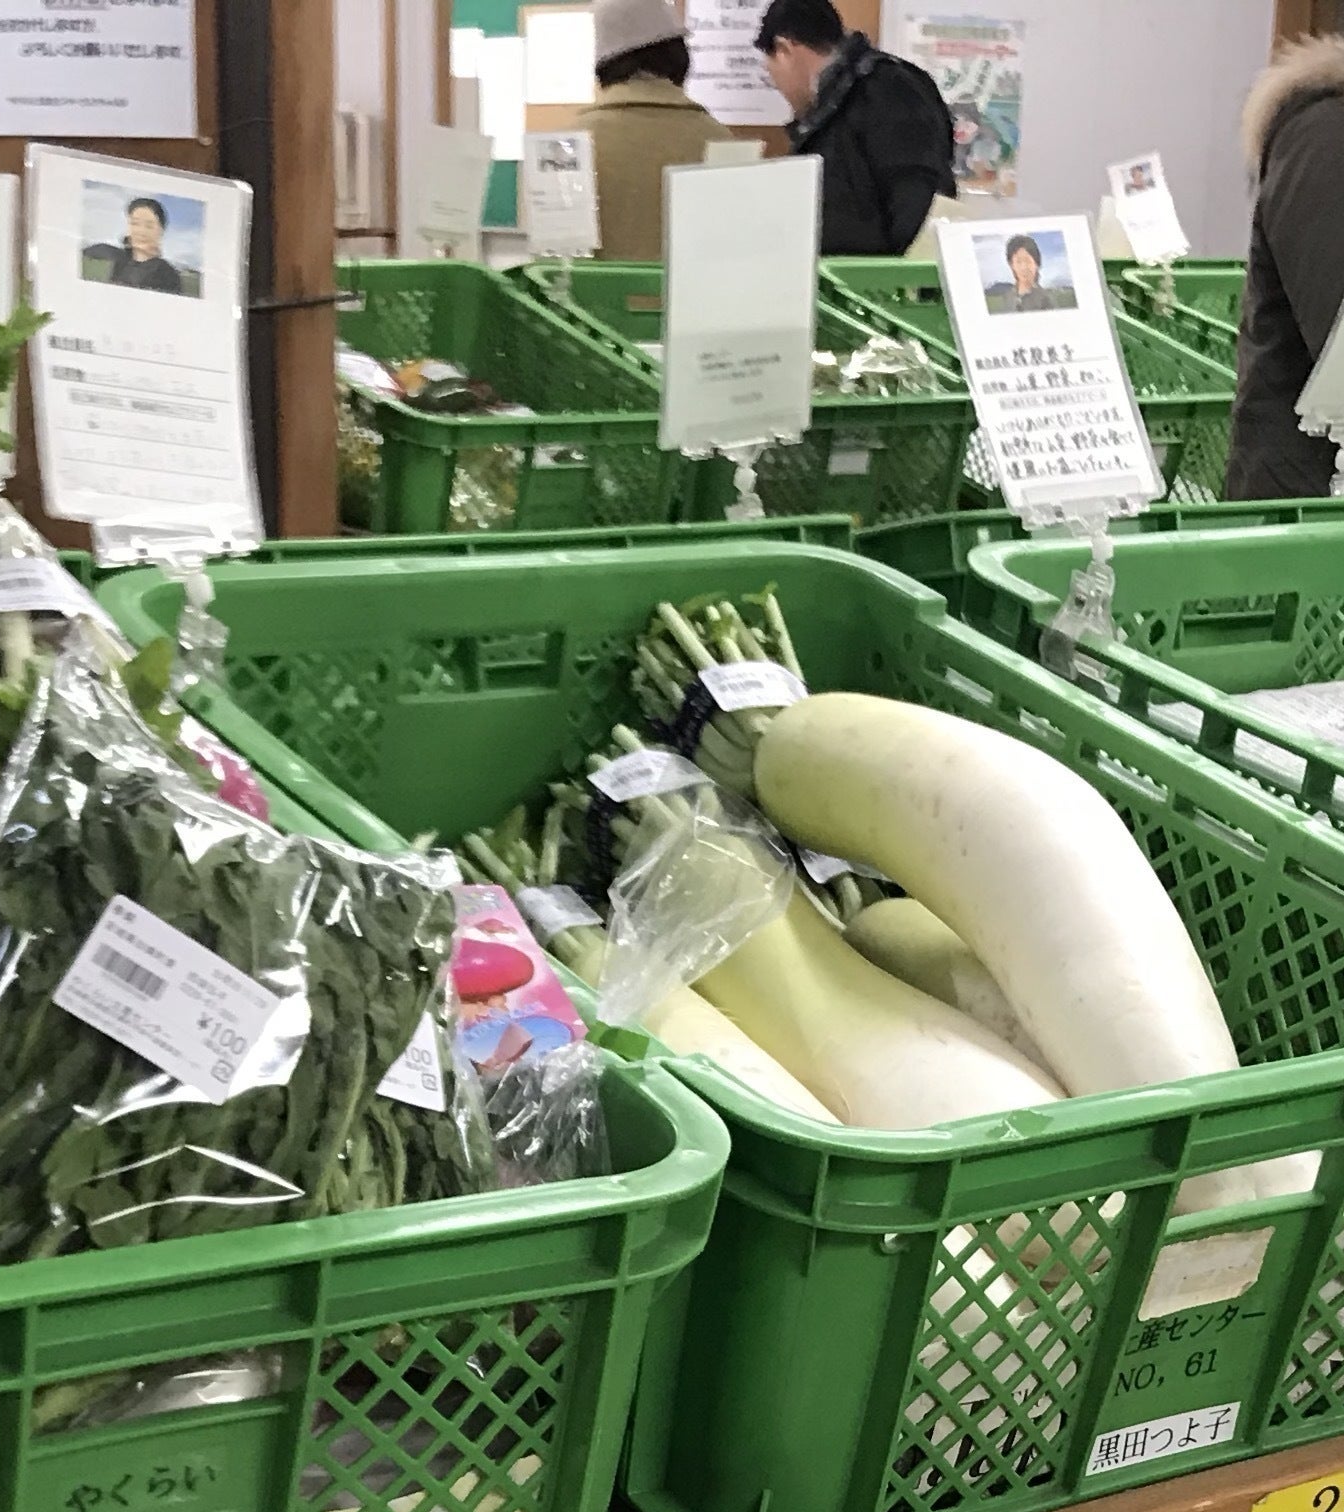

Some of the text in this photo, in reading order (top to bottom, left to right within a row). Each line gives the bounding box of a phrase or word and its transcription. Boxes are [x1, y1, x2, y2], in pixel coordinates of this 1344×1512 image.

[195, 1011, 249, 1056] ¥100
[1184, 1348, 1218, 1377] 61
[1092, 1407, 1232, 1472] 黒田つよ子
